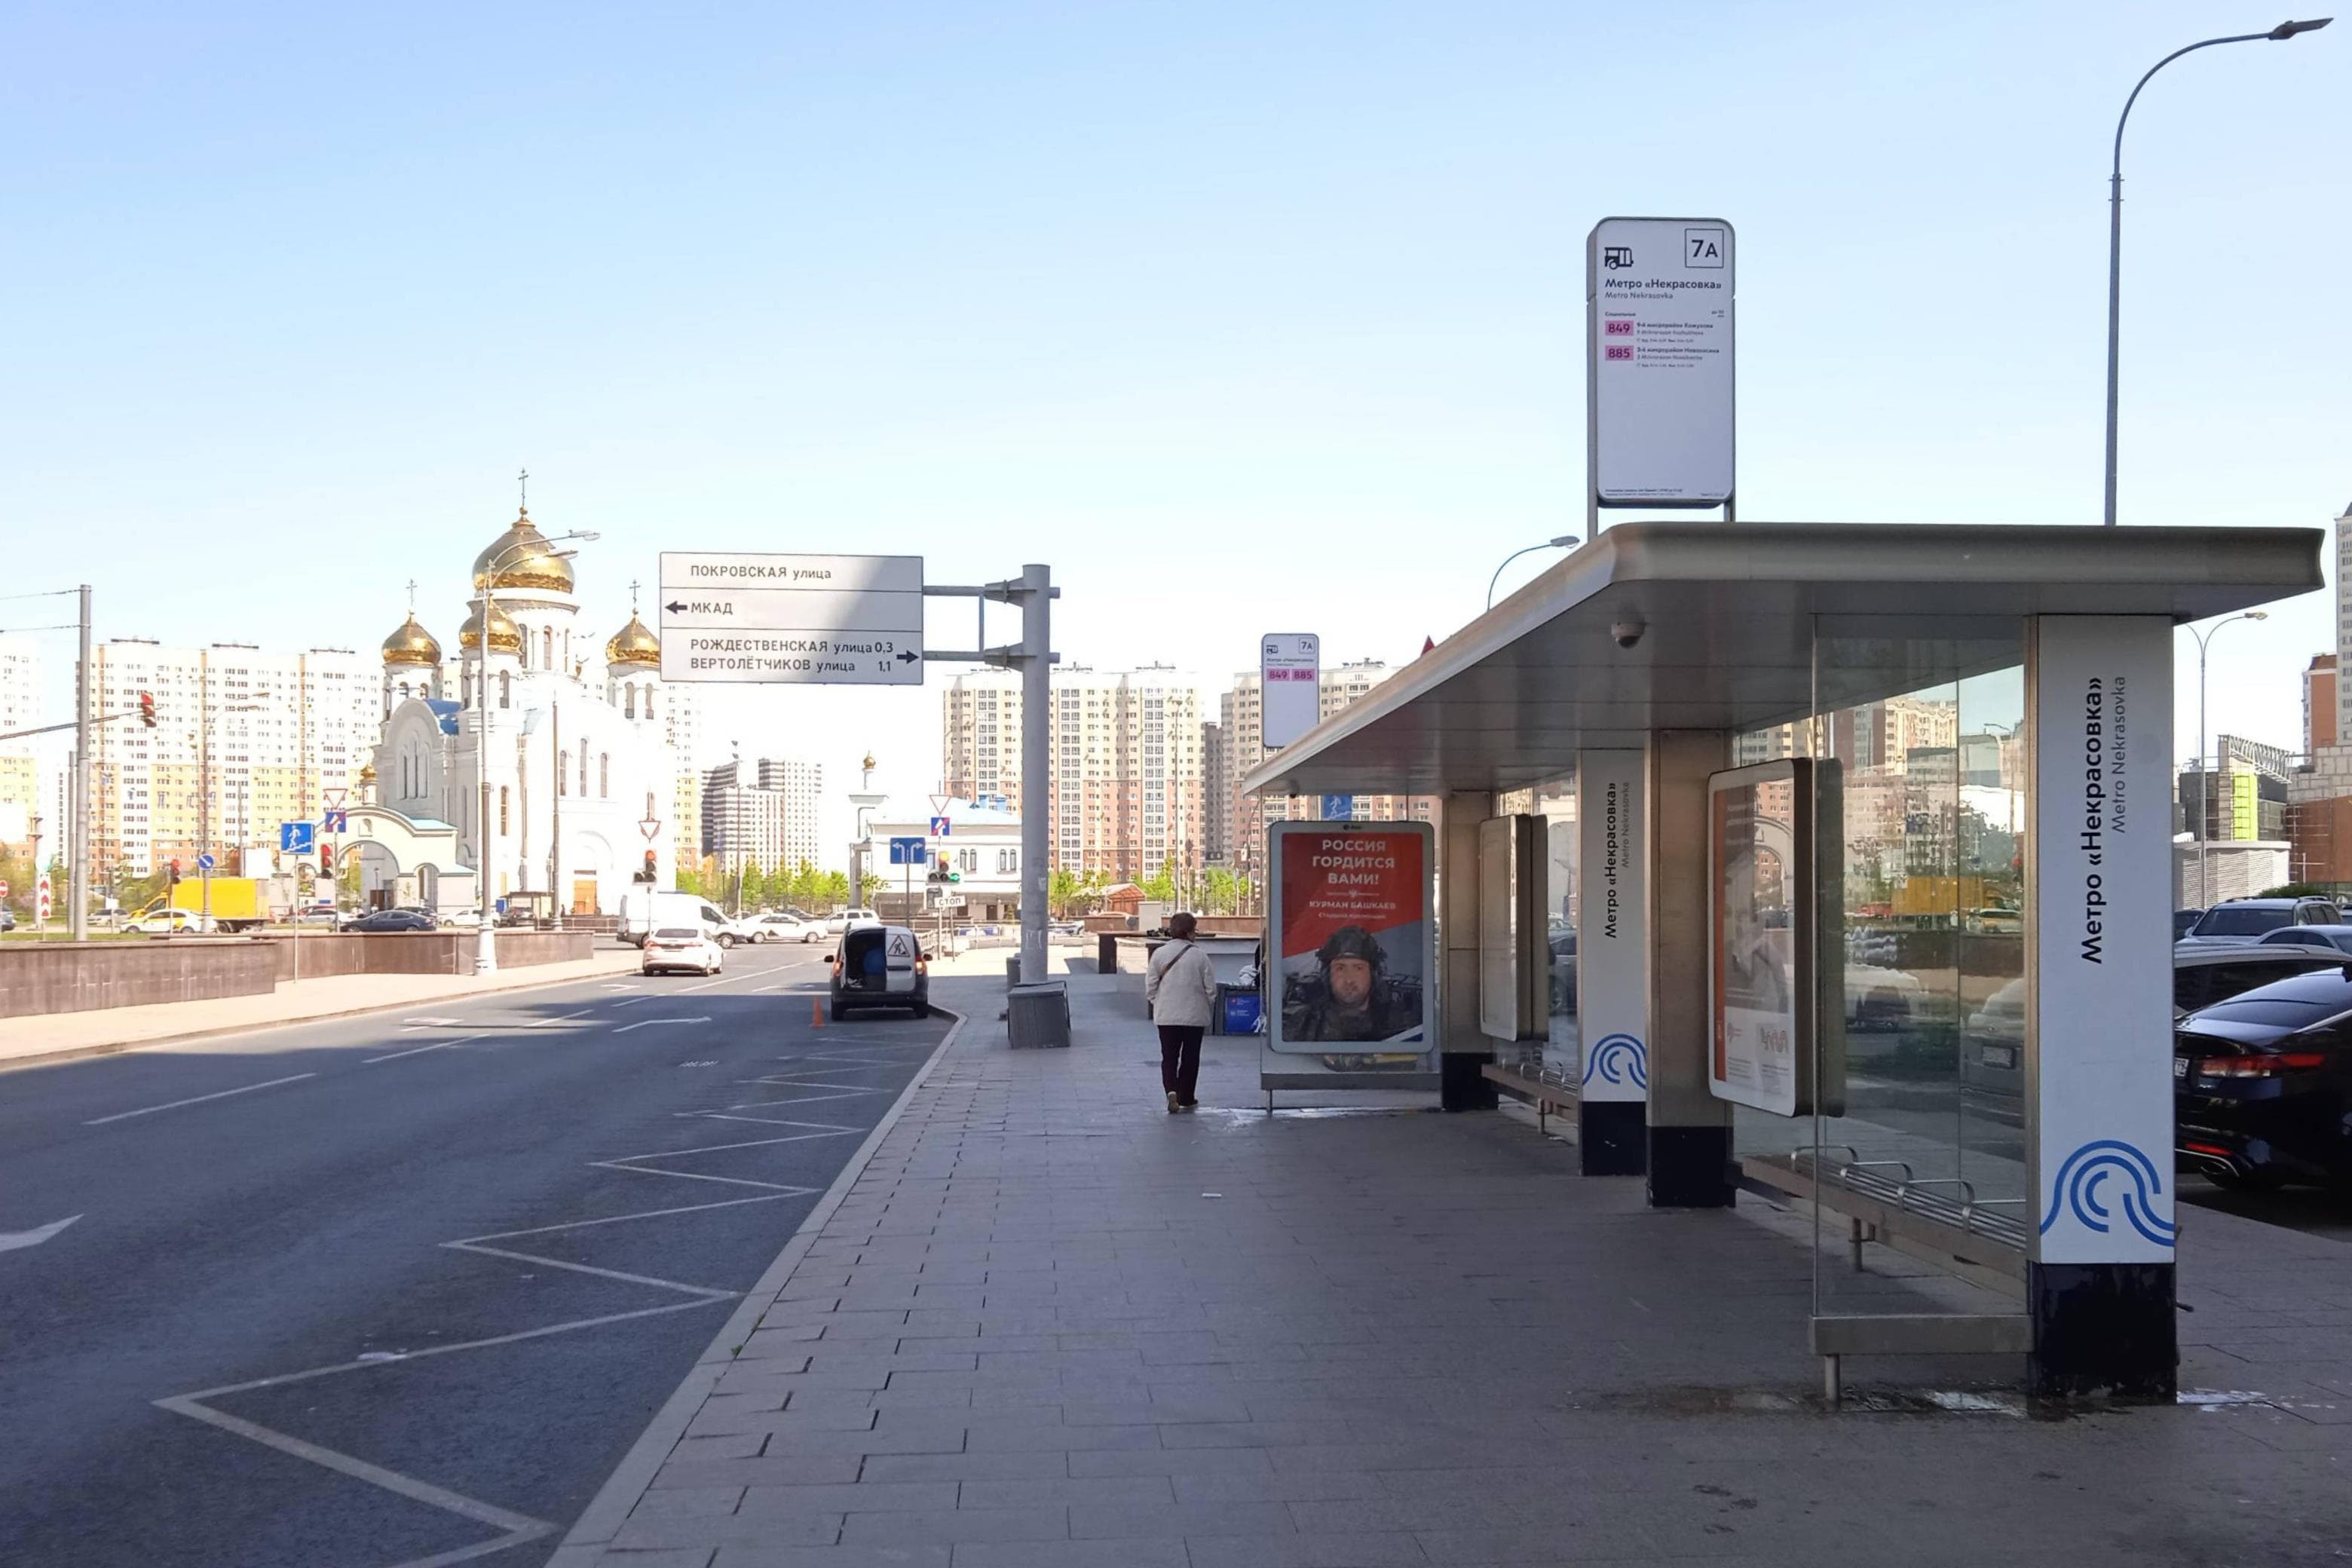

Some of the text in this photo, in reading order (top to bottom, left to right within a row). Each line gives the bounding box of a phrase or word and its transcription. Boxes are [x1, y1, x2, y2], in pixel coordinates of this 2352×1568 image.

[1605, 279, 1722, 290] Метро «Некрасовка»
[1608, 323, 1631, 333] 849
[1608, 348, 1631, 358] 885
[691, 565, 831, 580] ПОКРОВСКАЯ улица
[691, 602, 733, 615] МКАД
[691, 639, 828, 653] РОЖДЕСТВЕНСКАЯ
[833, 642, 873, 654] улица
[691, 656, 810, 670] ВЕРТОЛЁТЧИКОВ
[816, 661, 855, 672] улица
[1269, 670, 1312, 679] 849 885
[2111, 676, 2126, 833] Metro Nekrasovka
[2081, 678, 2106, 964] Метро «Некрасовка»
[1322, 839, 1386, 852] РОССИЯ
[1622, 839, 1630, 868] Metro
[1312, 856, 1395, 869] ГОРДИТСЯ
[1604, 782, 1619, 939] Метро «Некрасовка»
[1328, 873, 1380, 885] ВАМИ!
